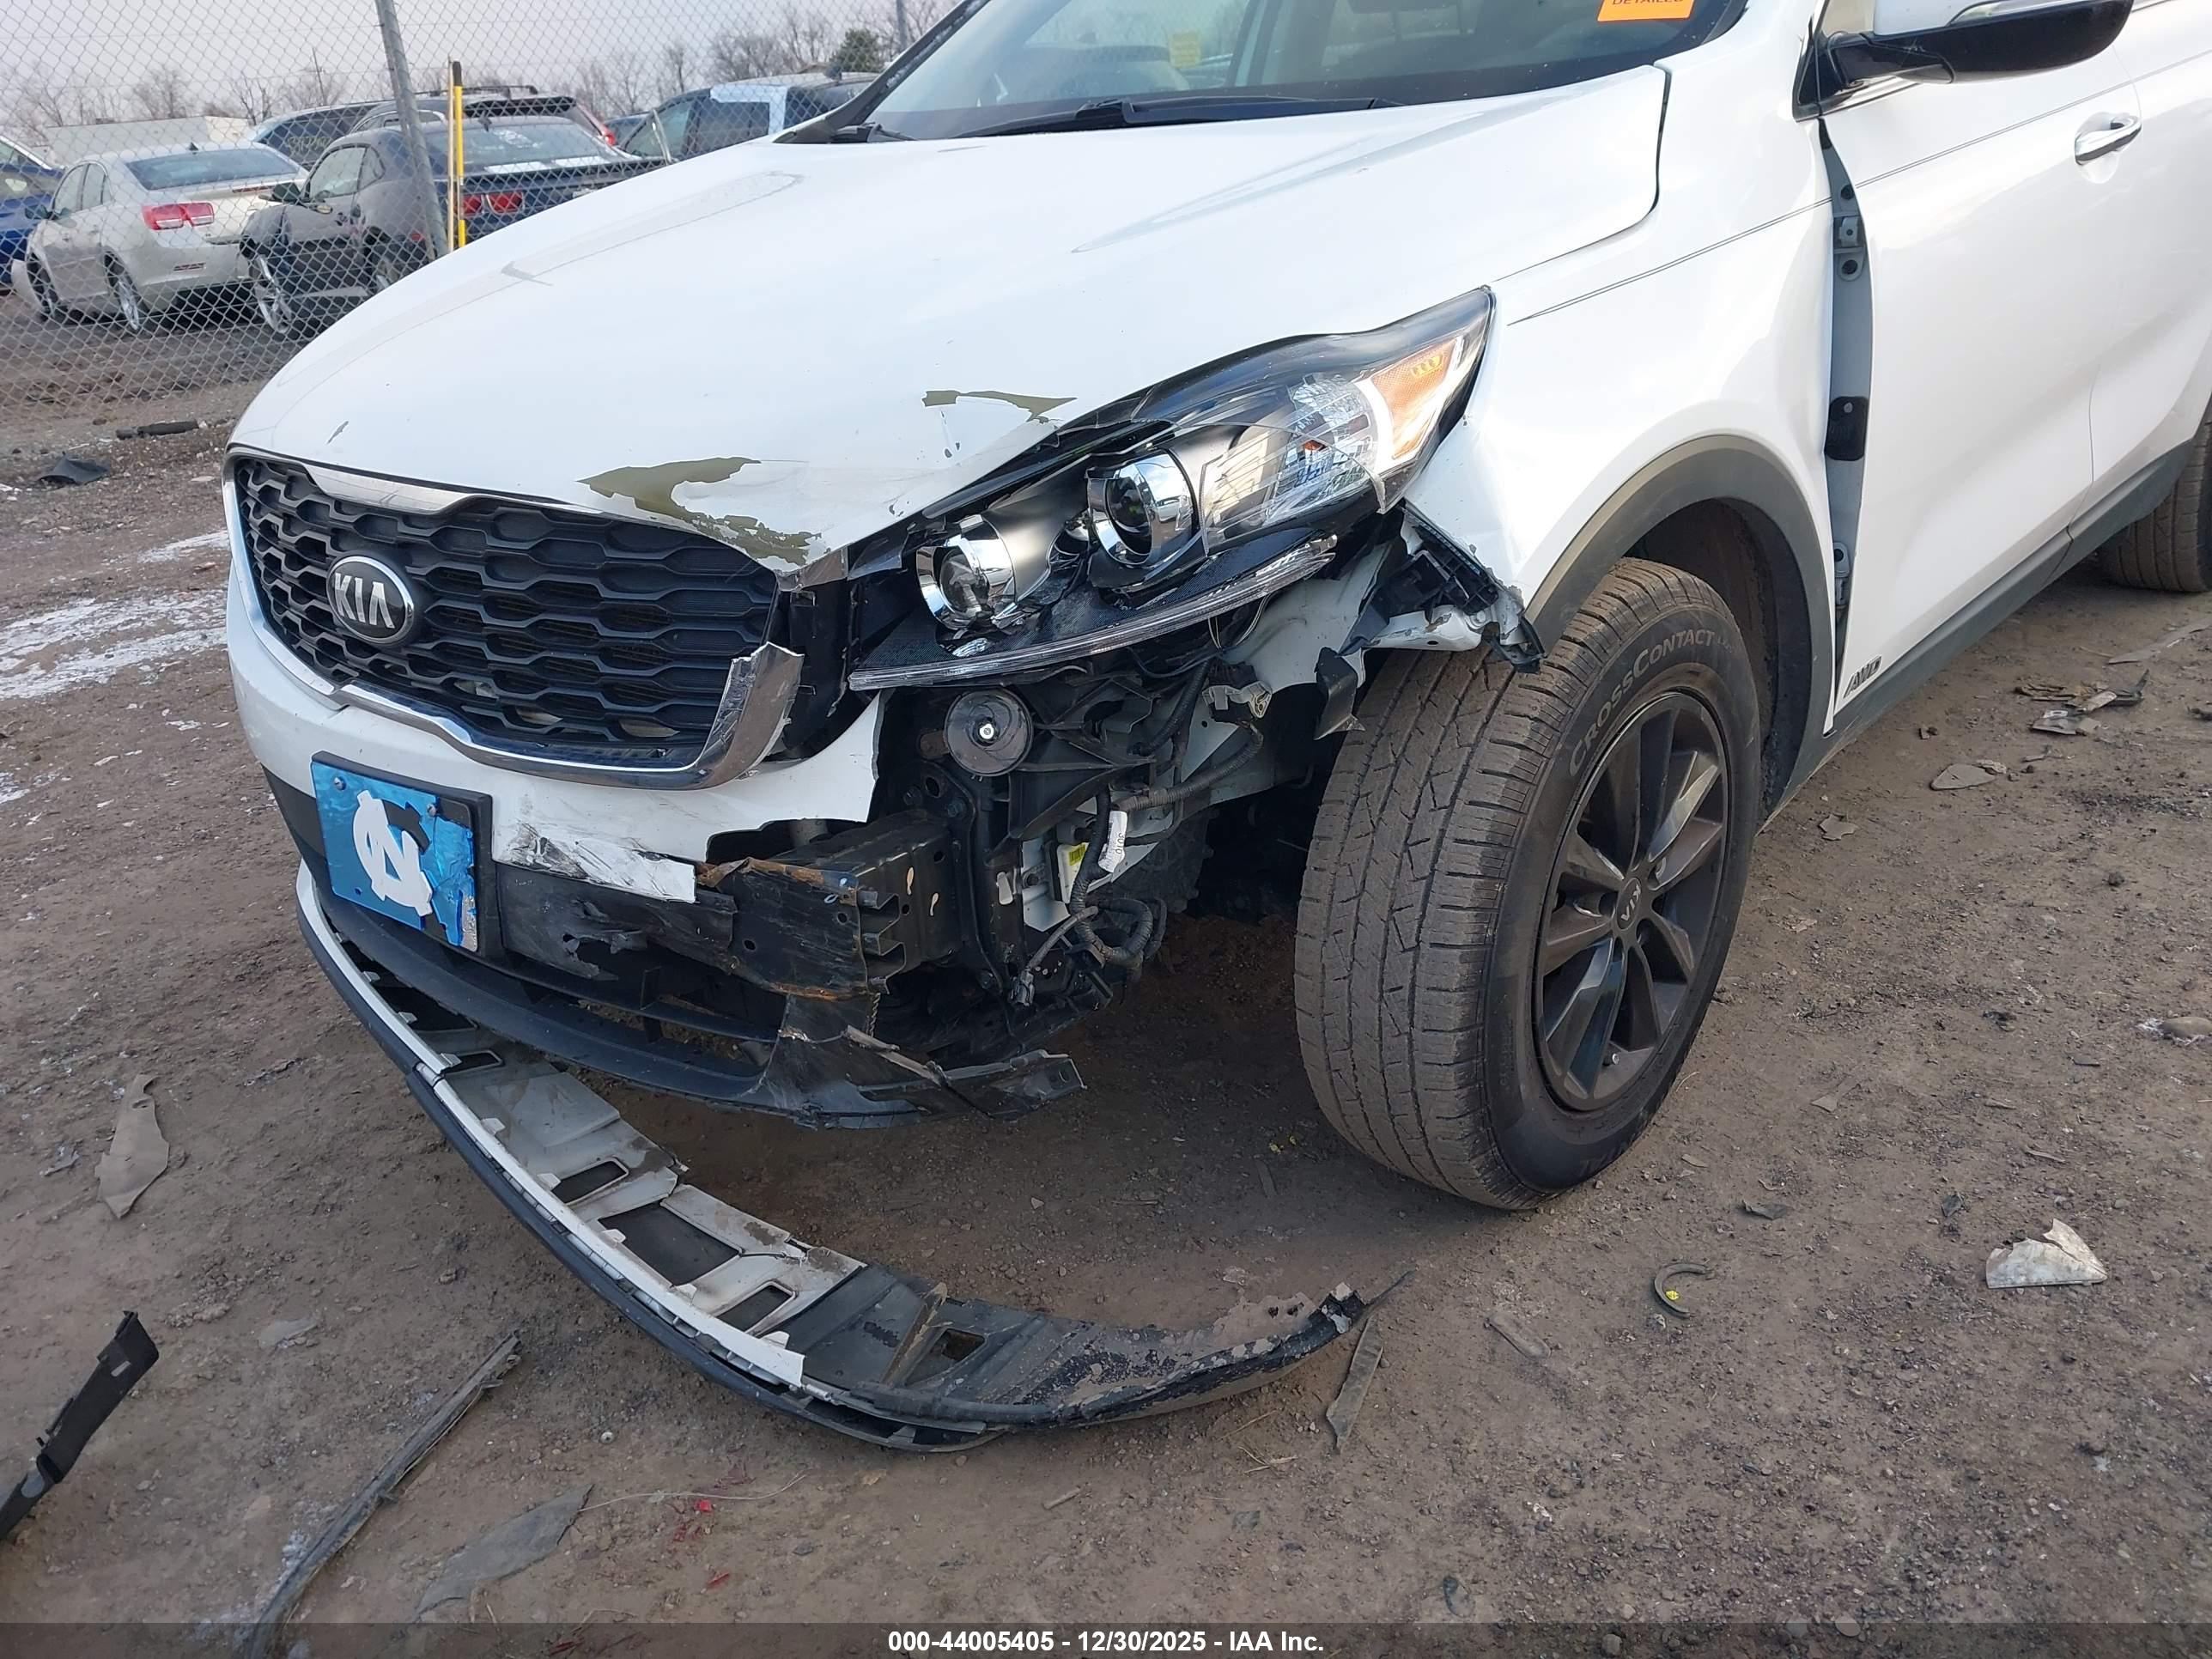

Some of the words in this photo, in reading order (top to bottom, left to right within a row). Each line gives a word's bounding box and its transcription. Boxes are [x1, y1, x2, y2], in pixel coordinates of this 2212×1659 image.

[334, 572, 396, 629] KIA
[1842, 655, 1882, 700] AWD
[1620, 884, 1641, 921] KIA
